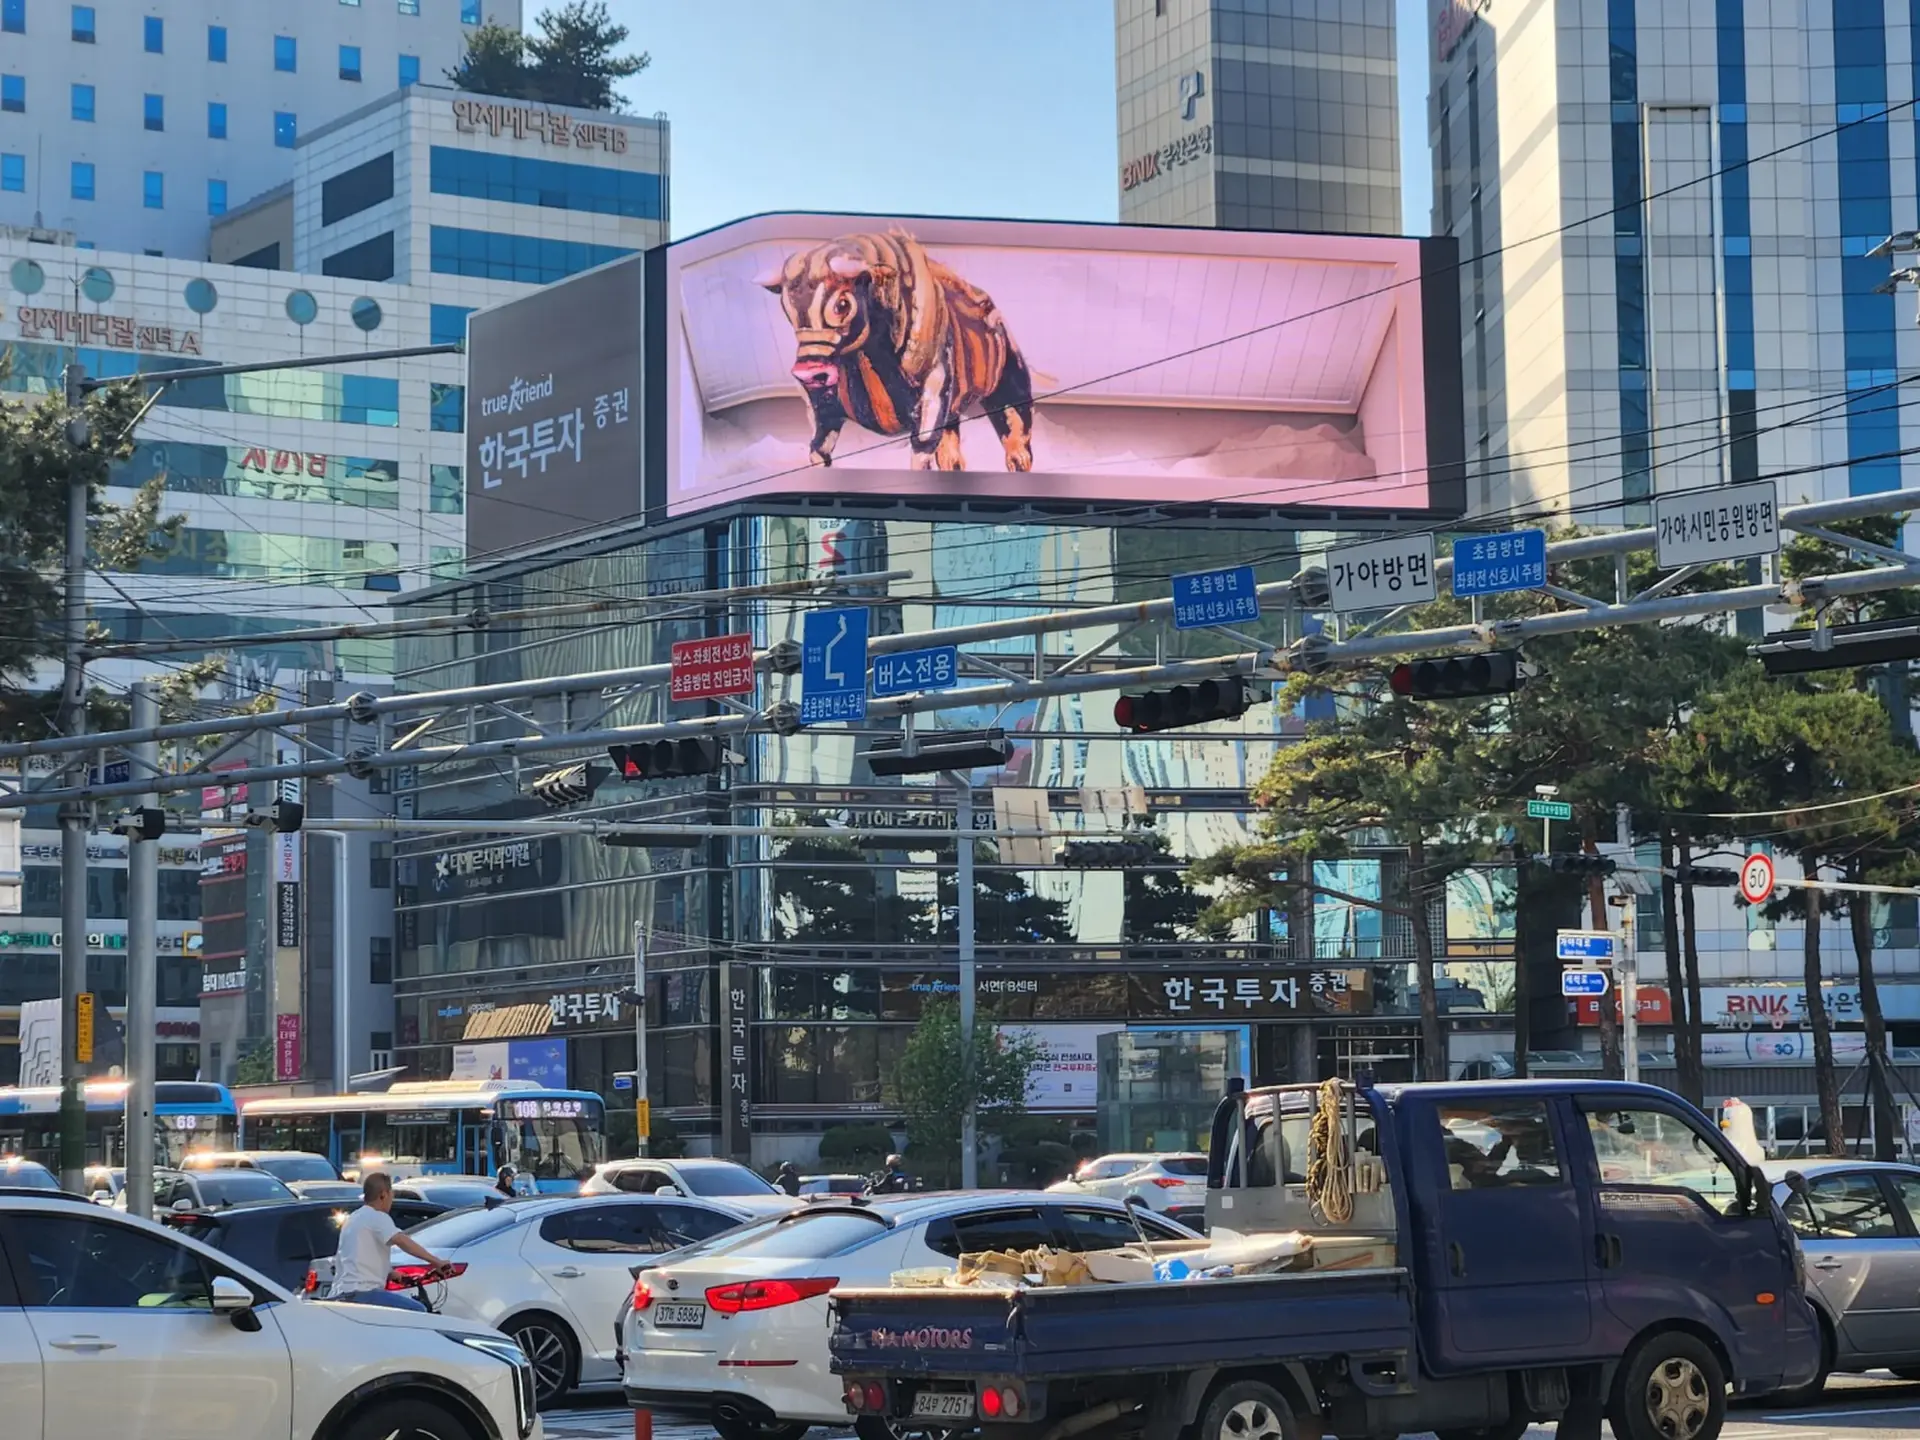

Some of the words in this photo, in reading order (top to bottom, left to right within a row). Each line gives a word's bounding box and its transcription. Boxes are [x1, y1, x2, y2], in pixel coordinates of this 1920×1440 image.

[1122, 149, 1163, 192] BNK
[478, 407, 585, 489] 한국투자
[593, 387, 629, 429] 증권
[1472, 536, 1526, 560] 초읍방면
[1333, 552, 1429, 592] 가야방면
[1749, 867, 1766, 890] 50
[1162, 977, 1300, 1011] 한국투자
[1309, 972, 1349, 993] 증권
[1726, 994, 1789, 1017] BNK
[549, 993, 621, 1027] 한국투자
[730, 988, 747, 1094] 한국투자
[176, 1115, 197, 1130] 68
[901, 1327, 973, 1350] MOTORS
